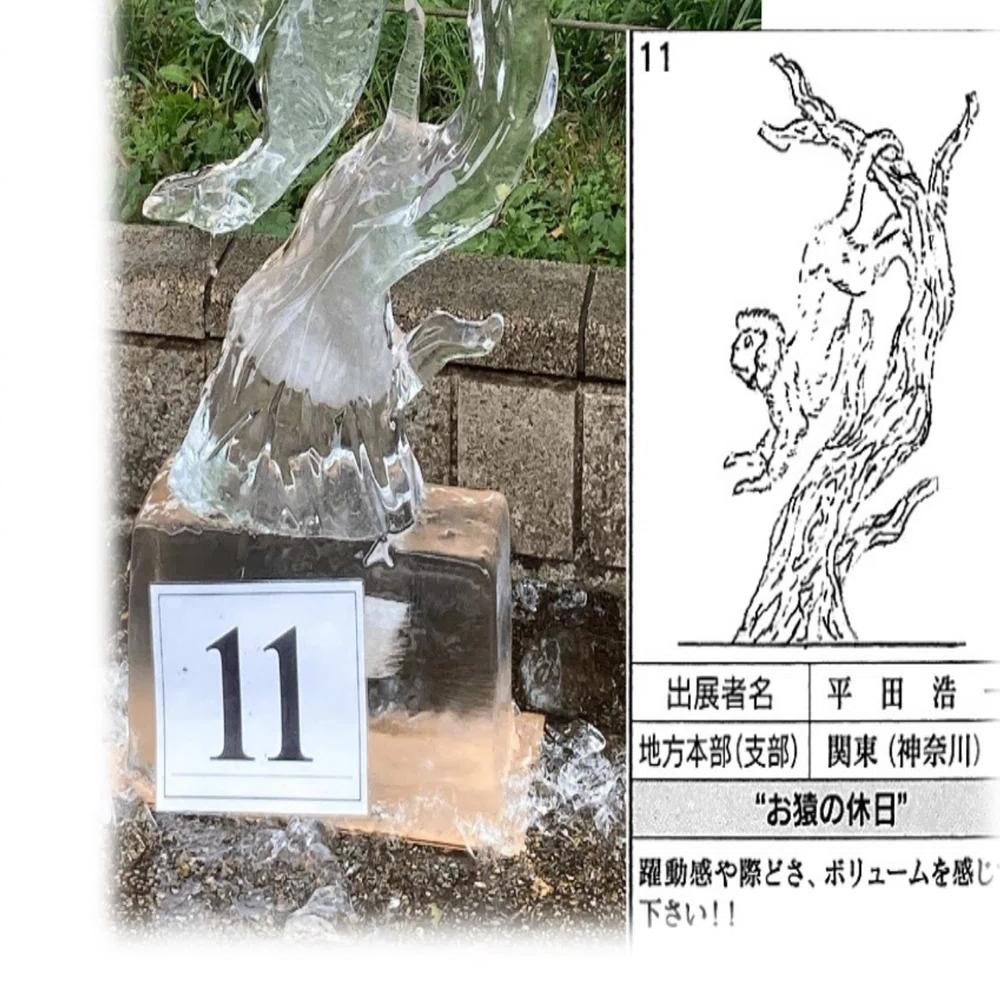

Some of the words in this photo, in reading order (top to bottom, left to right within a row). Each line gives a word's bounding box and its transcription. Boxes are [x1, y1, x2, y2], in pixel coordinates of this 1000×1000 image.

[640, 41, 669, 72] 11
[206, 626, 313, 762] 11
[667, 675, 773, 711] 出展者名
[638, 856, 999, 889] 躍動感や際どさ、ボリュームを感じ
